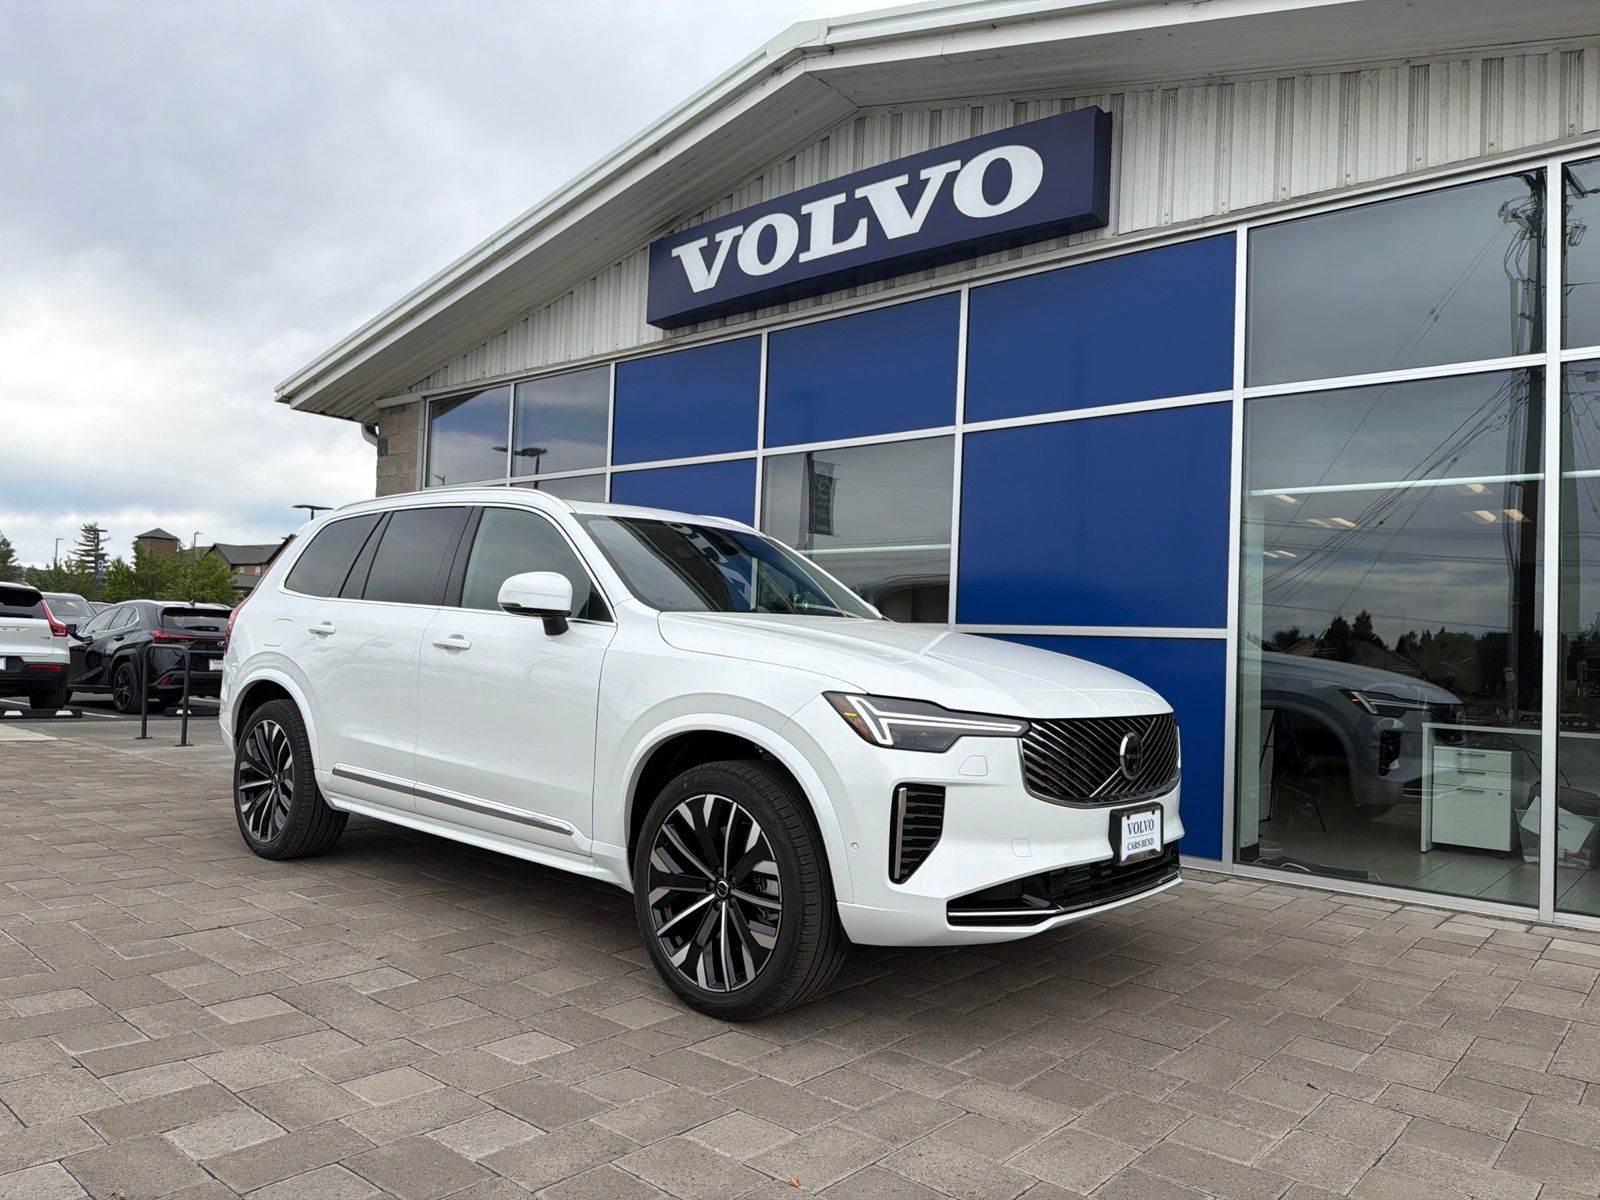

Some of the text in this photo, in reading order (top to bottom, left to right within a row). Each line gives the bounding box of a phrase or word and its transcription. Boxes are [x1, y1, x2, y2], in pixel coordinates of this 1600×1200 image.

[672, 145, 1044, 293] VOLVO
[1127, 818, 1155, 836] VOLVO
[1127, 837, 1155, 851] CARS BEND
